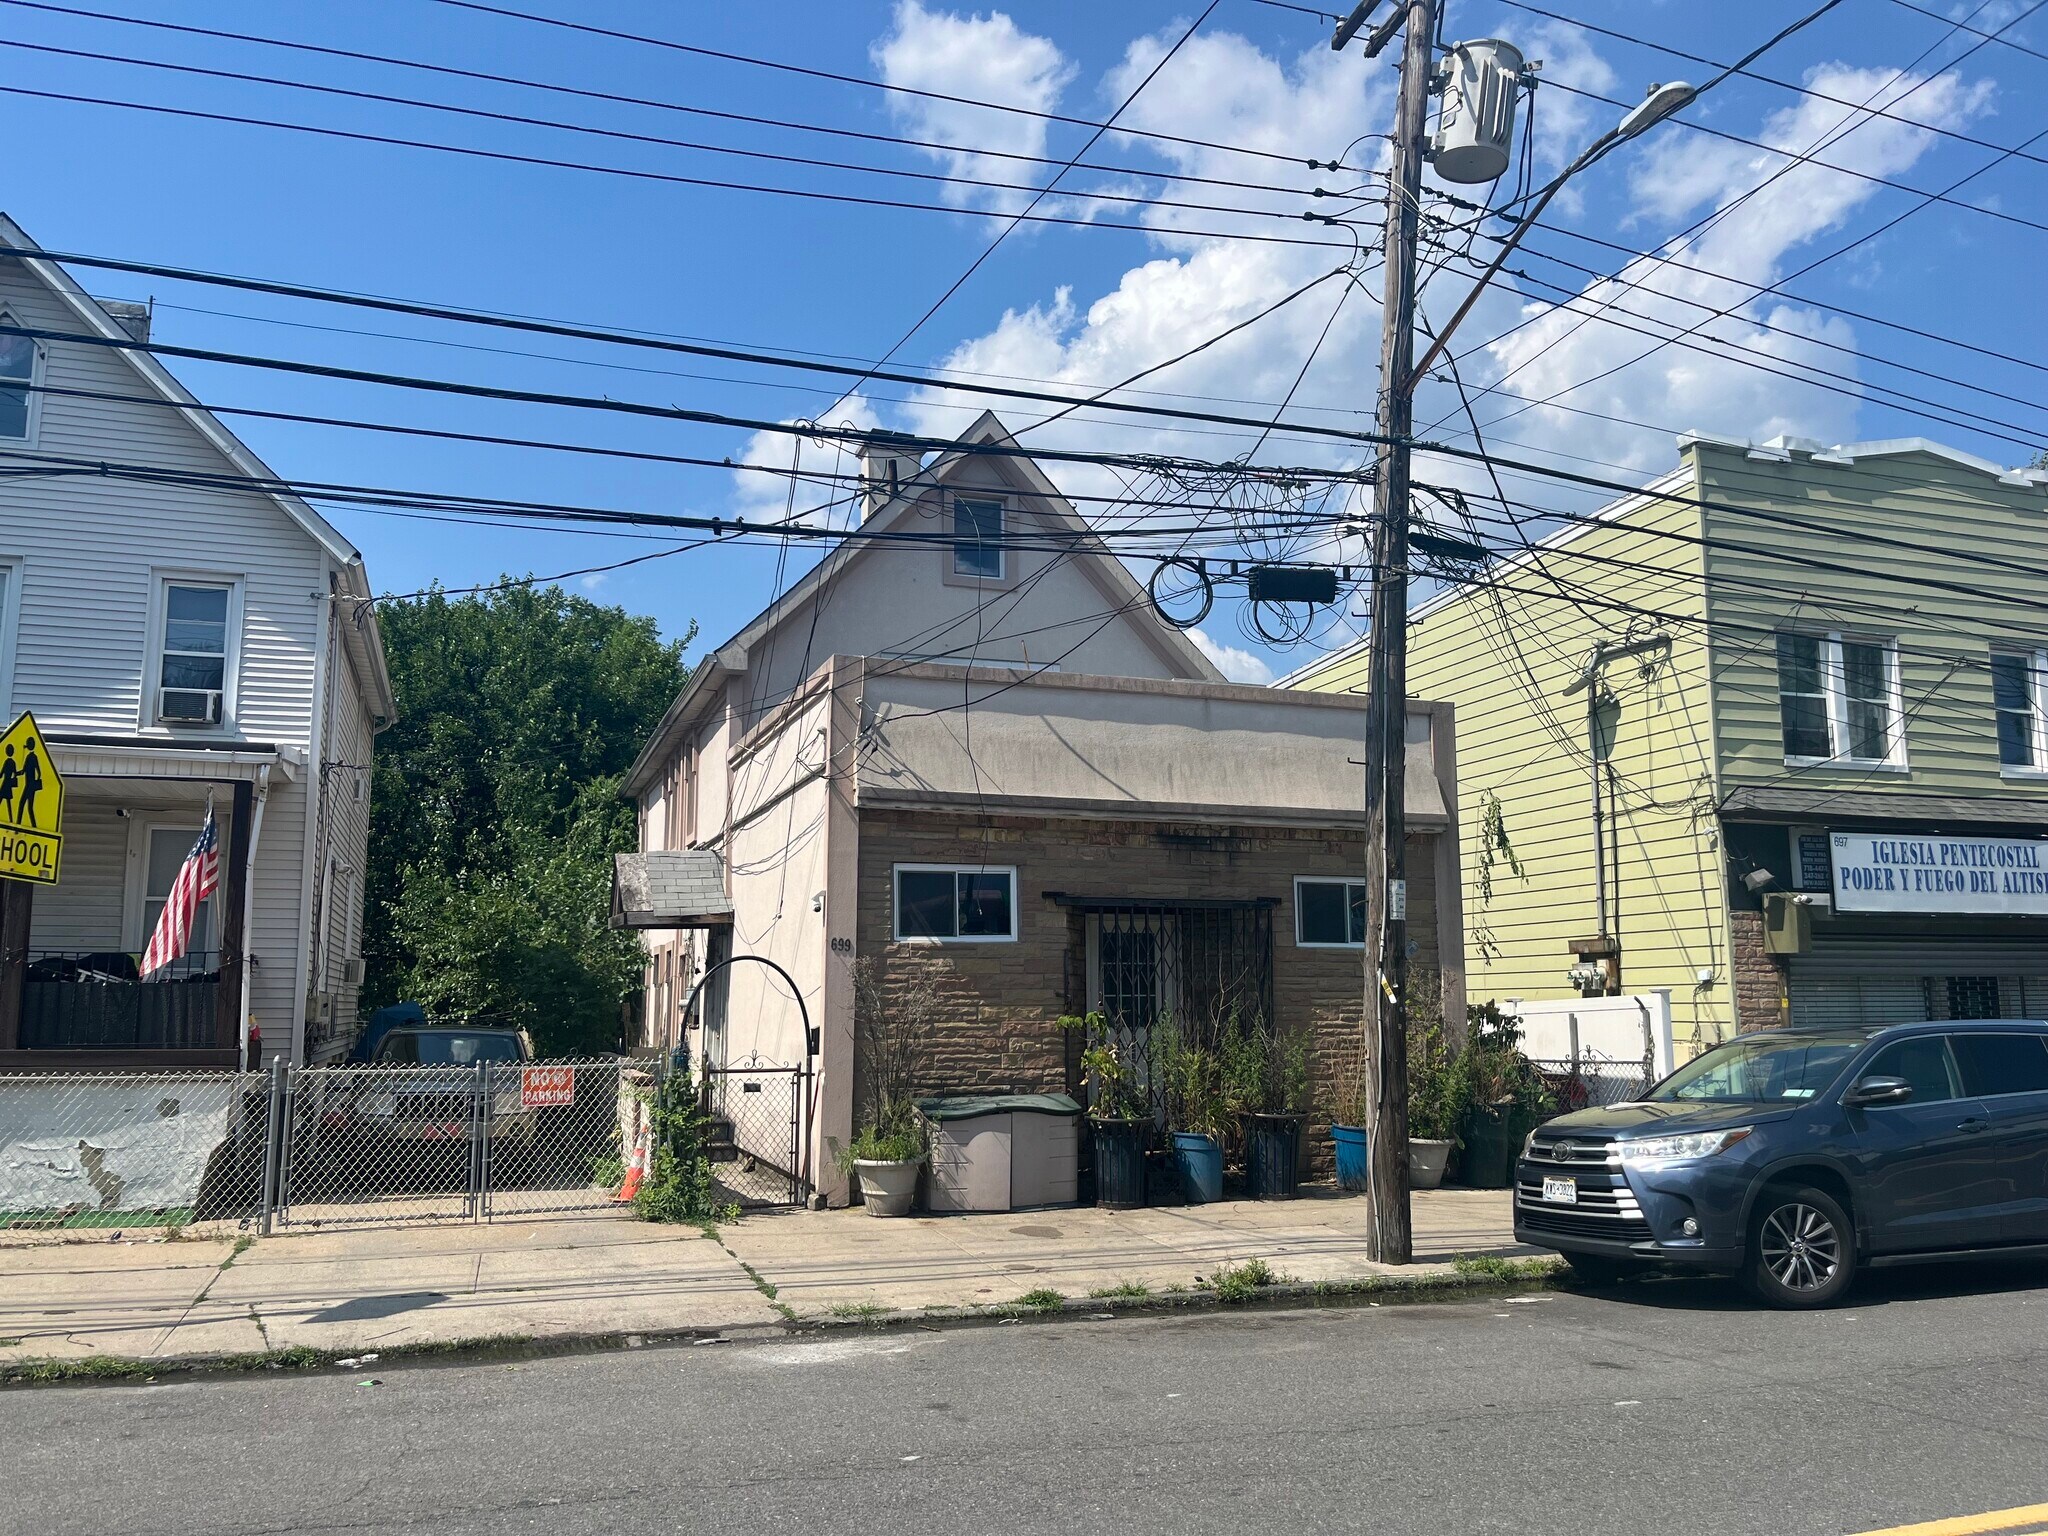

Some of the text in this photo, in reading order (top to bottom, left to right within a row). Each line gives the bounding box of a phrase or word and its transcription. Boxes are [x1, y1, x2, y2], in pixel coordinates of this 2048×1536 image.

[1834, 837, 1848, 847] 697
[1871, 841, 2039, 868] IGLESIA PENTECOSTAL
[1840, 867, 1895, 890] PODER
[1899, 869, 1908, 890] Y
[1914, 869, 1964, 891] FUEGO
[1969, 870, 1997, 892] DEL
[831, 937, 851, 951] 699
[531, 1072, 549, 1086] NO
[525, 1089, 571, 1102] PARKING
